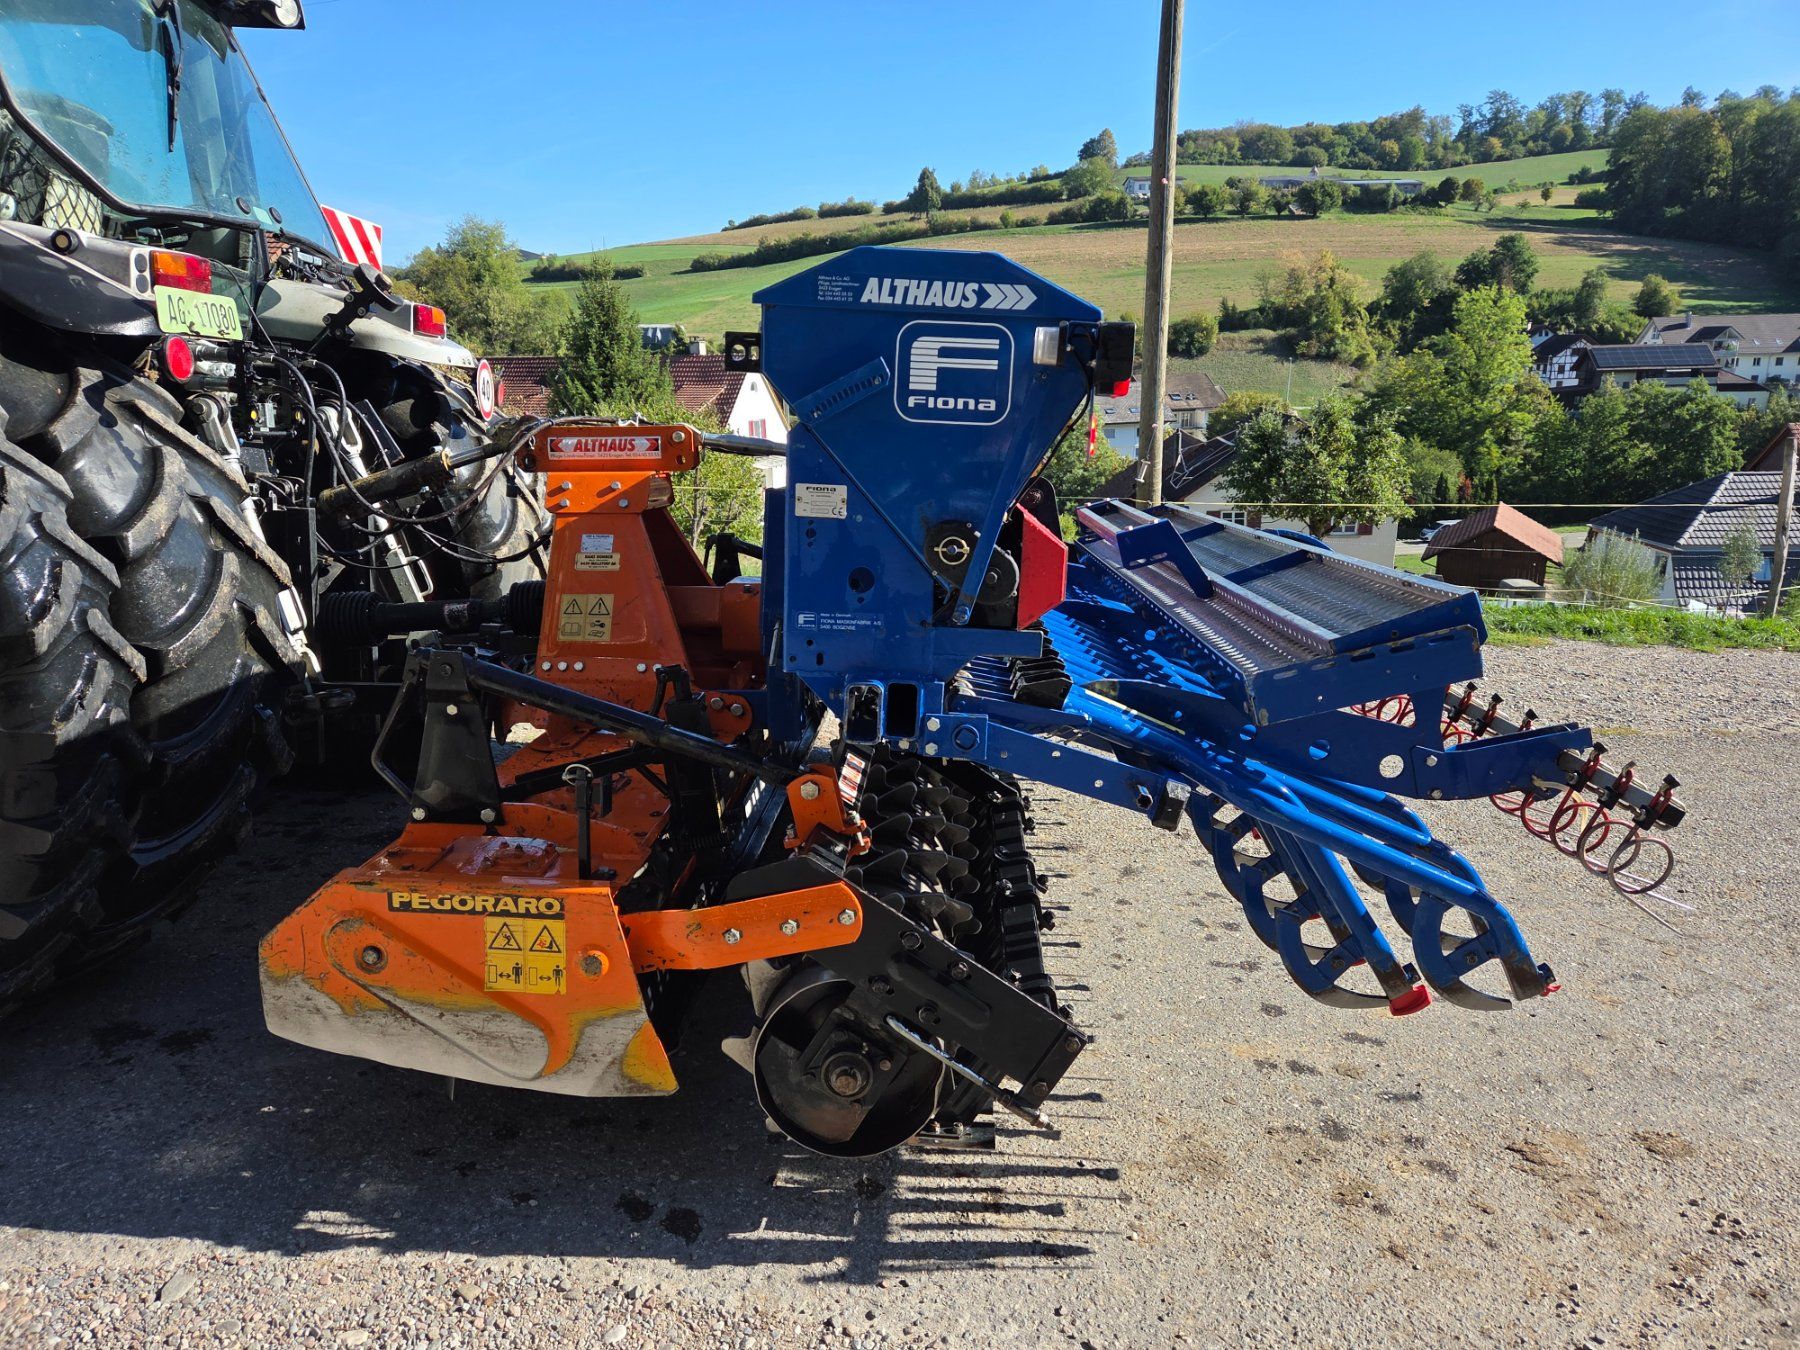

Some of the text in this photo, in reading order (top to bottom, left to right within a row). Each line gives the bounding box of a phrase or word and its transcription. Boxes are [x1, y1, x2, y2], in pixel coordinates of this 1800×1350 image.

[860, 277, 979, 308] ALTHAUS
[167, 294, 237, 332] AG 17080
[481, 376, 490, 401] 40
[574, 438, 636, 452] ALTHAUS
[392, 892, 561, 915] PEGORARO
